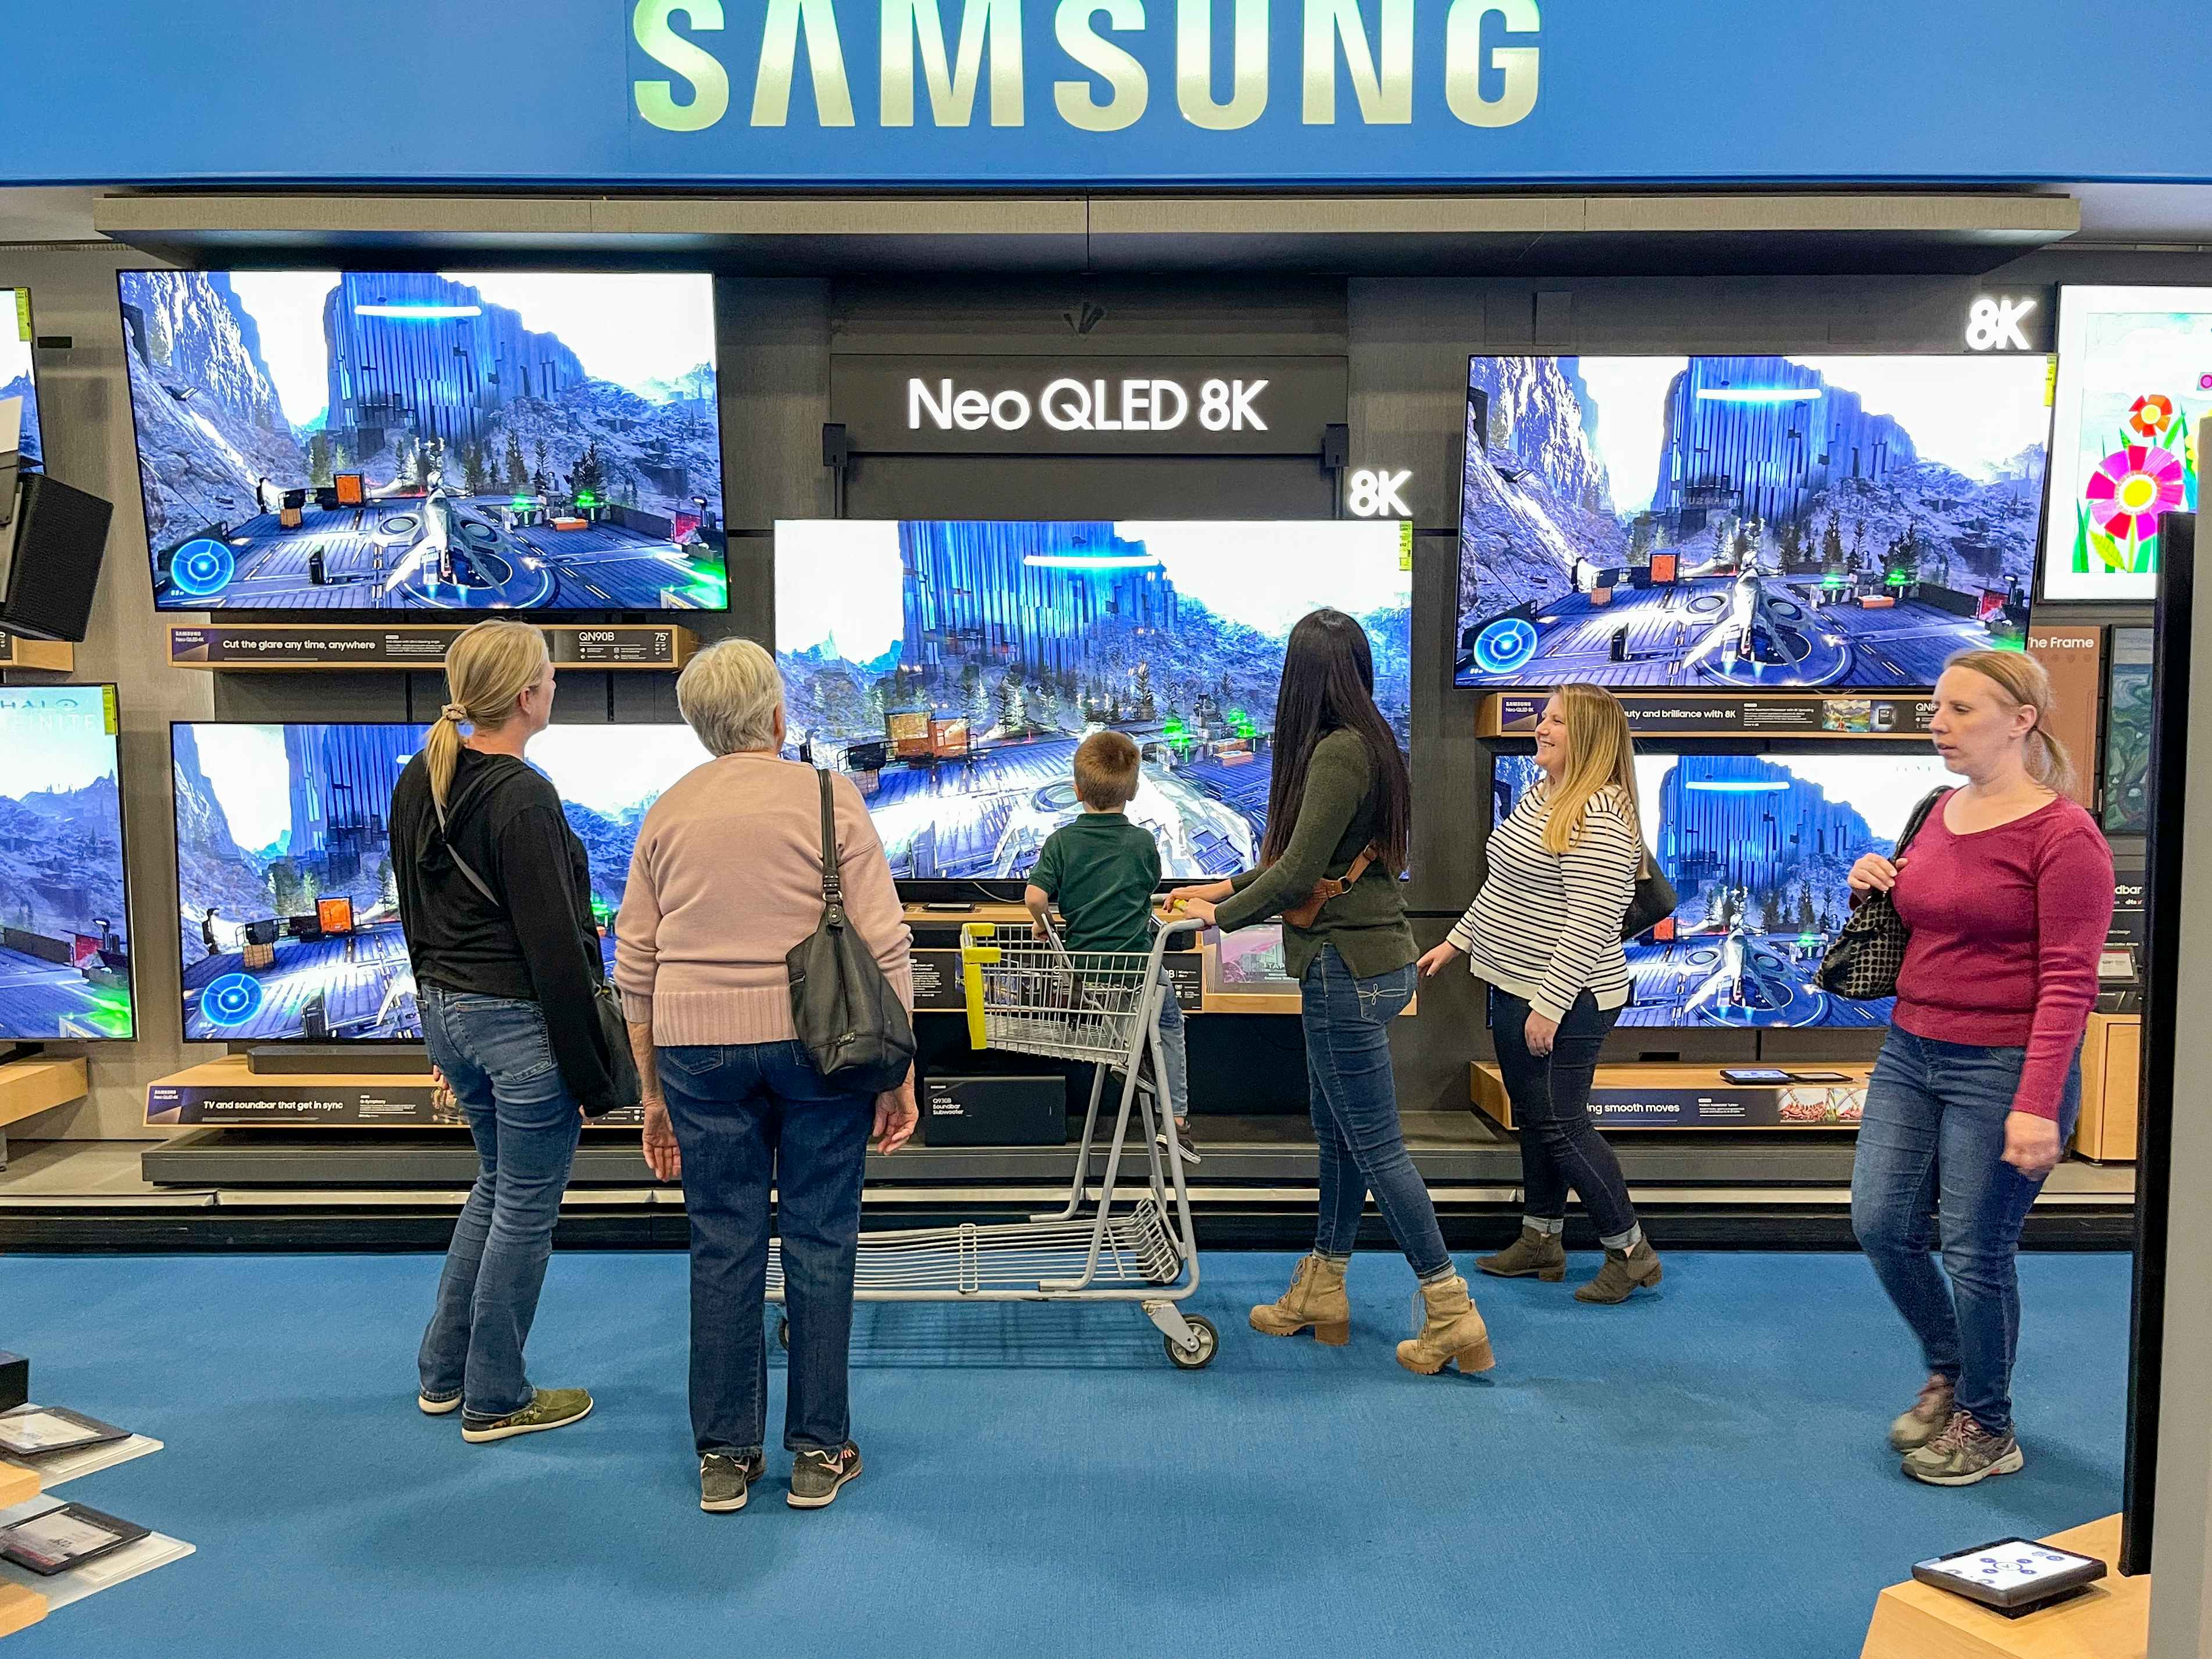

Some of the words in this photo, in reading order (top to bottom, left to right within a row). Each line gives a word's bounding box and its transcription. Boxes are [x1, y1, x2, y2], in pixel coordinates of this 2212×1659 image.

[634, 0, 1540, 131] SAMSUNG
[1965, 299, 2038, 349] 8K
[908, 377, 1031, 430] Neo
[1040, 377, 1189, 431] QLED
[1198, 377, 1270, 431] 8K
[1348, 469, 1413, 517] 8K
[579, 632, 615, 641] QN90B
[223, 640, 240, 648] Cut
[241, 640, 257, 648] the
[258, 640, 283, 651] glare
[284, 641, 302, 651] any
[304, 640, 327, 650] time,
[328, 641, 376, 651] anywhere
[2050, 637, 2094, 648] Frame
[1624, 709, 1641, 720] uty
[1643, 709, 1660, 718] and
[1662, 709, 1702, 718] brilliance
[1703, 709, 1724, 718] with
[1725, 710, 1736, 718] 8K
[2115, 884, 2143, 894] dbar
[204, 1101, 215, 1109] TV
[216, 1101, 234, 1109] and
[234, 1101, 277, 1109] soundbar
[297, 1101, 313, 1111] get
[313, 1100, 322, 1109] in
[323, 1102, 343, 1111] sync
[1586, 1103, 1603, 1115] ing
[1604, 1103, 1644, 1112] smooth
[1645, 1104, 1680, 1112] moves
